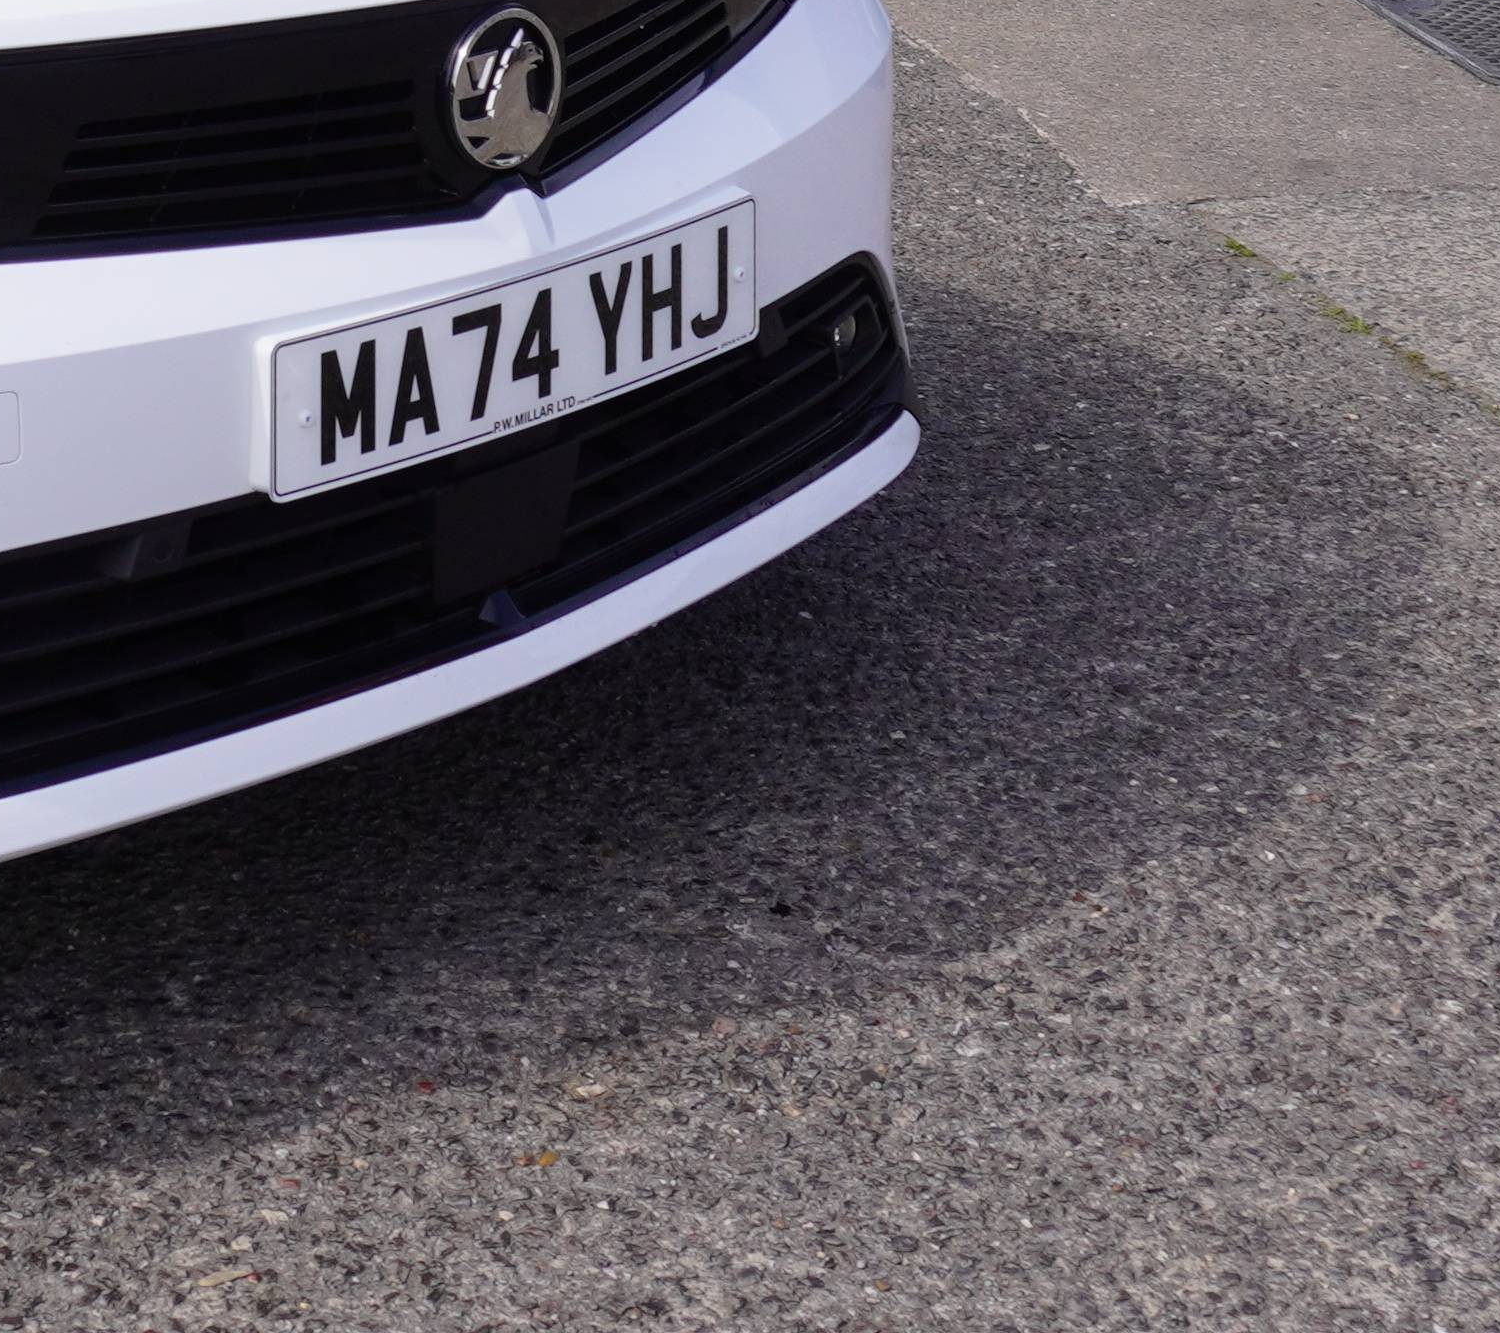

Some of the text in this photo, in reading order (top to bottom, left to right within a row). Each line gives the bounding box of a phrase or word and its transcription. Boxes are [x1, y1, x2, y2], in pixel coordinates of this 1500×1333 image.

[319, 226, 730, 466] MA74 YHJ
[556, 395, 577, 414] LTD
